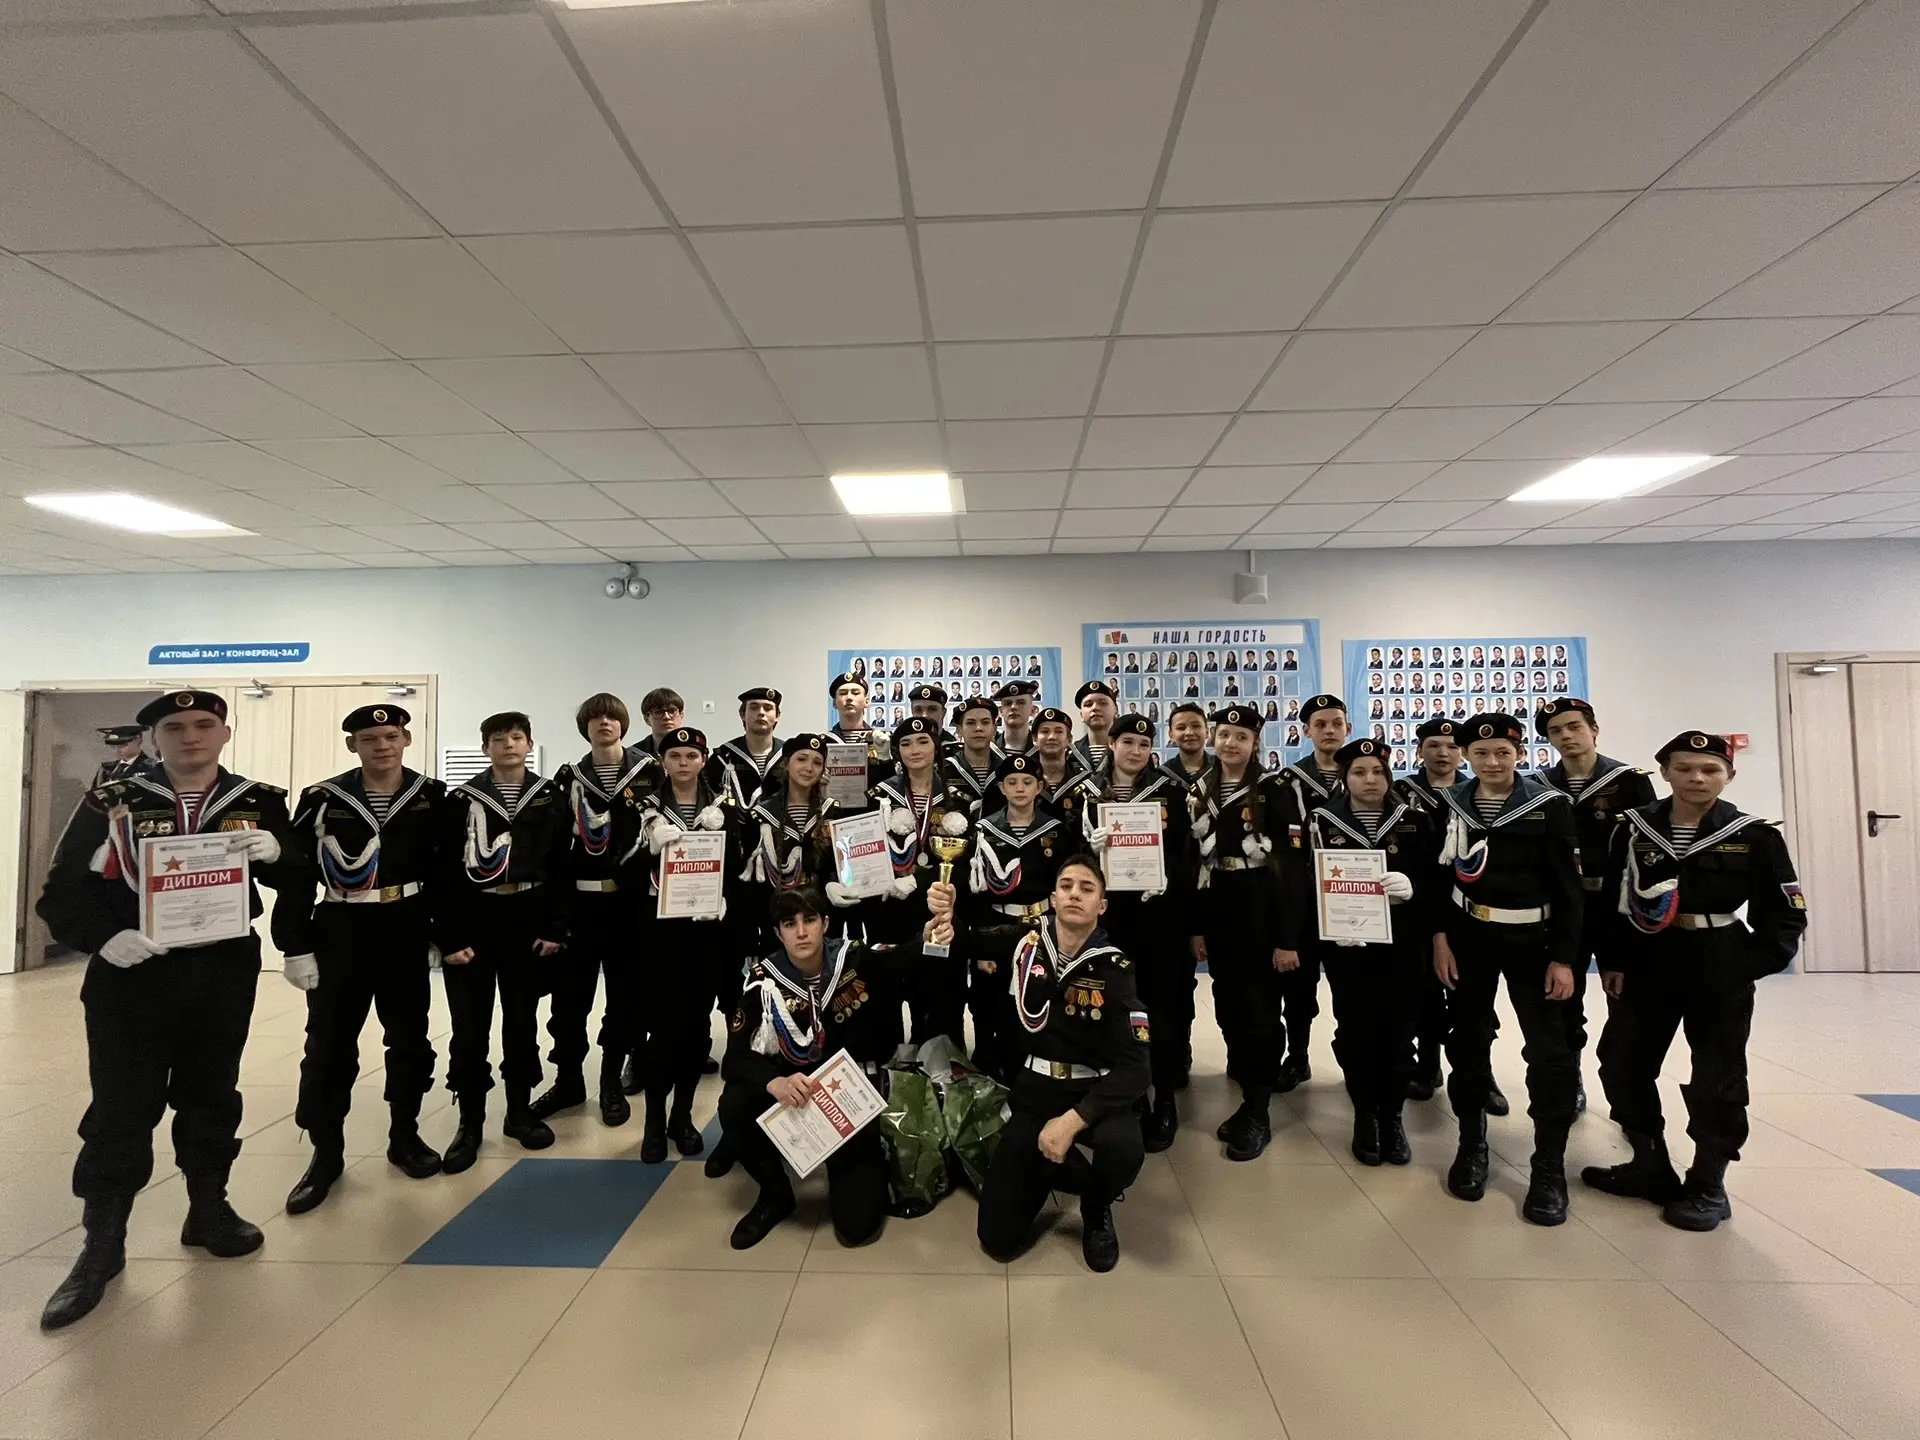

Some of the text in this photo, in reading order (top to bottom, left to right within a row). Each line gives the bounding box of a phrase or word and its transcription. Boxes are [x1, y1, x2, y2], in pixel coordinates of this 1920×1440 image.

[1152, 629, 1267, 645] НАША ГОРДОСТЬ
[158, 648, 300, 659] АКТОВЫЙ ЗАЛ КОНФЕРЕНЦ-ЗАЛ
[829, 767, 860, 776] ДИПЛОМ
[1111, 835, 1152, 846] ДИПЛОМ
[672, 861, 714, 874] ДИПЛОМ
[162, 870, 231, 891] ДИПЛОМ
[1329, 881, 1376, 893] ДИПЛОМ
[813, 1088, 849, 1131] ДИПЛОМ
